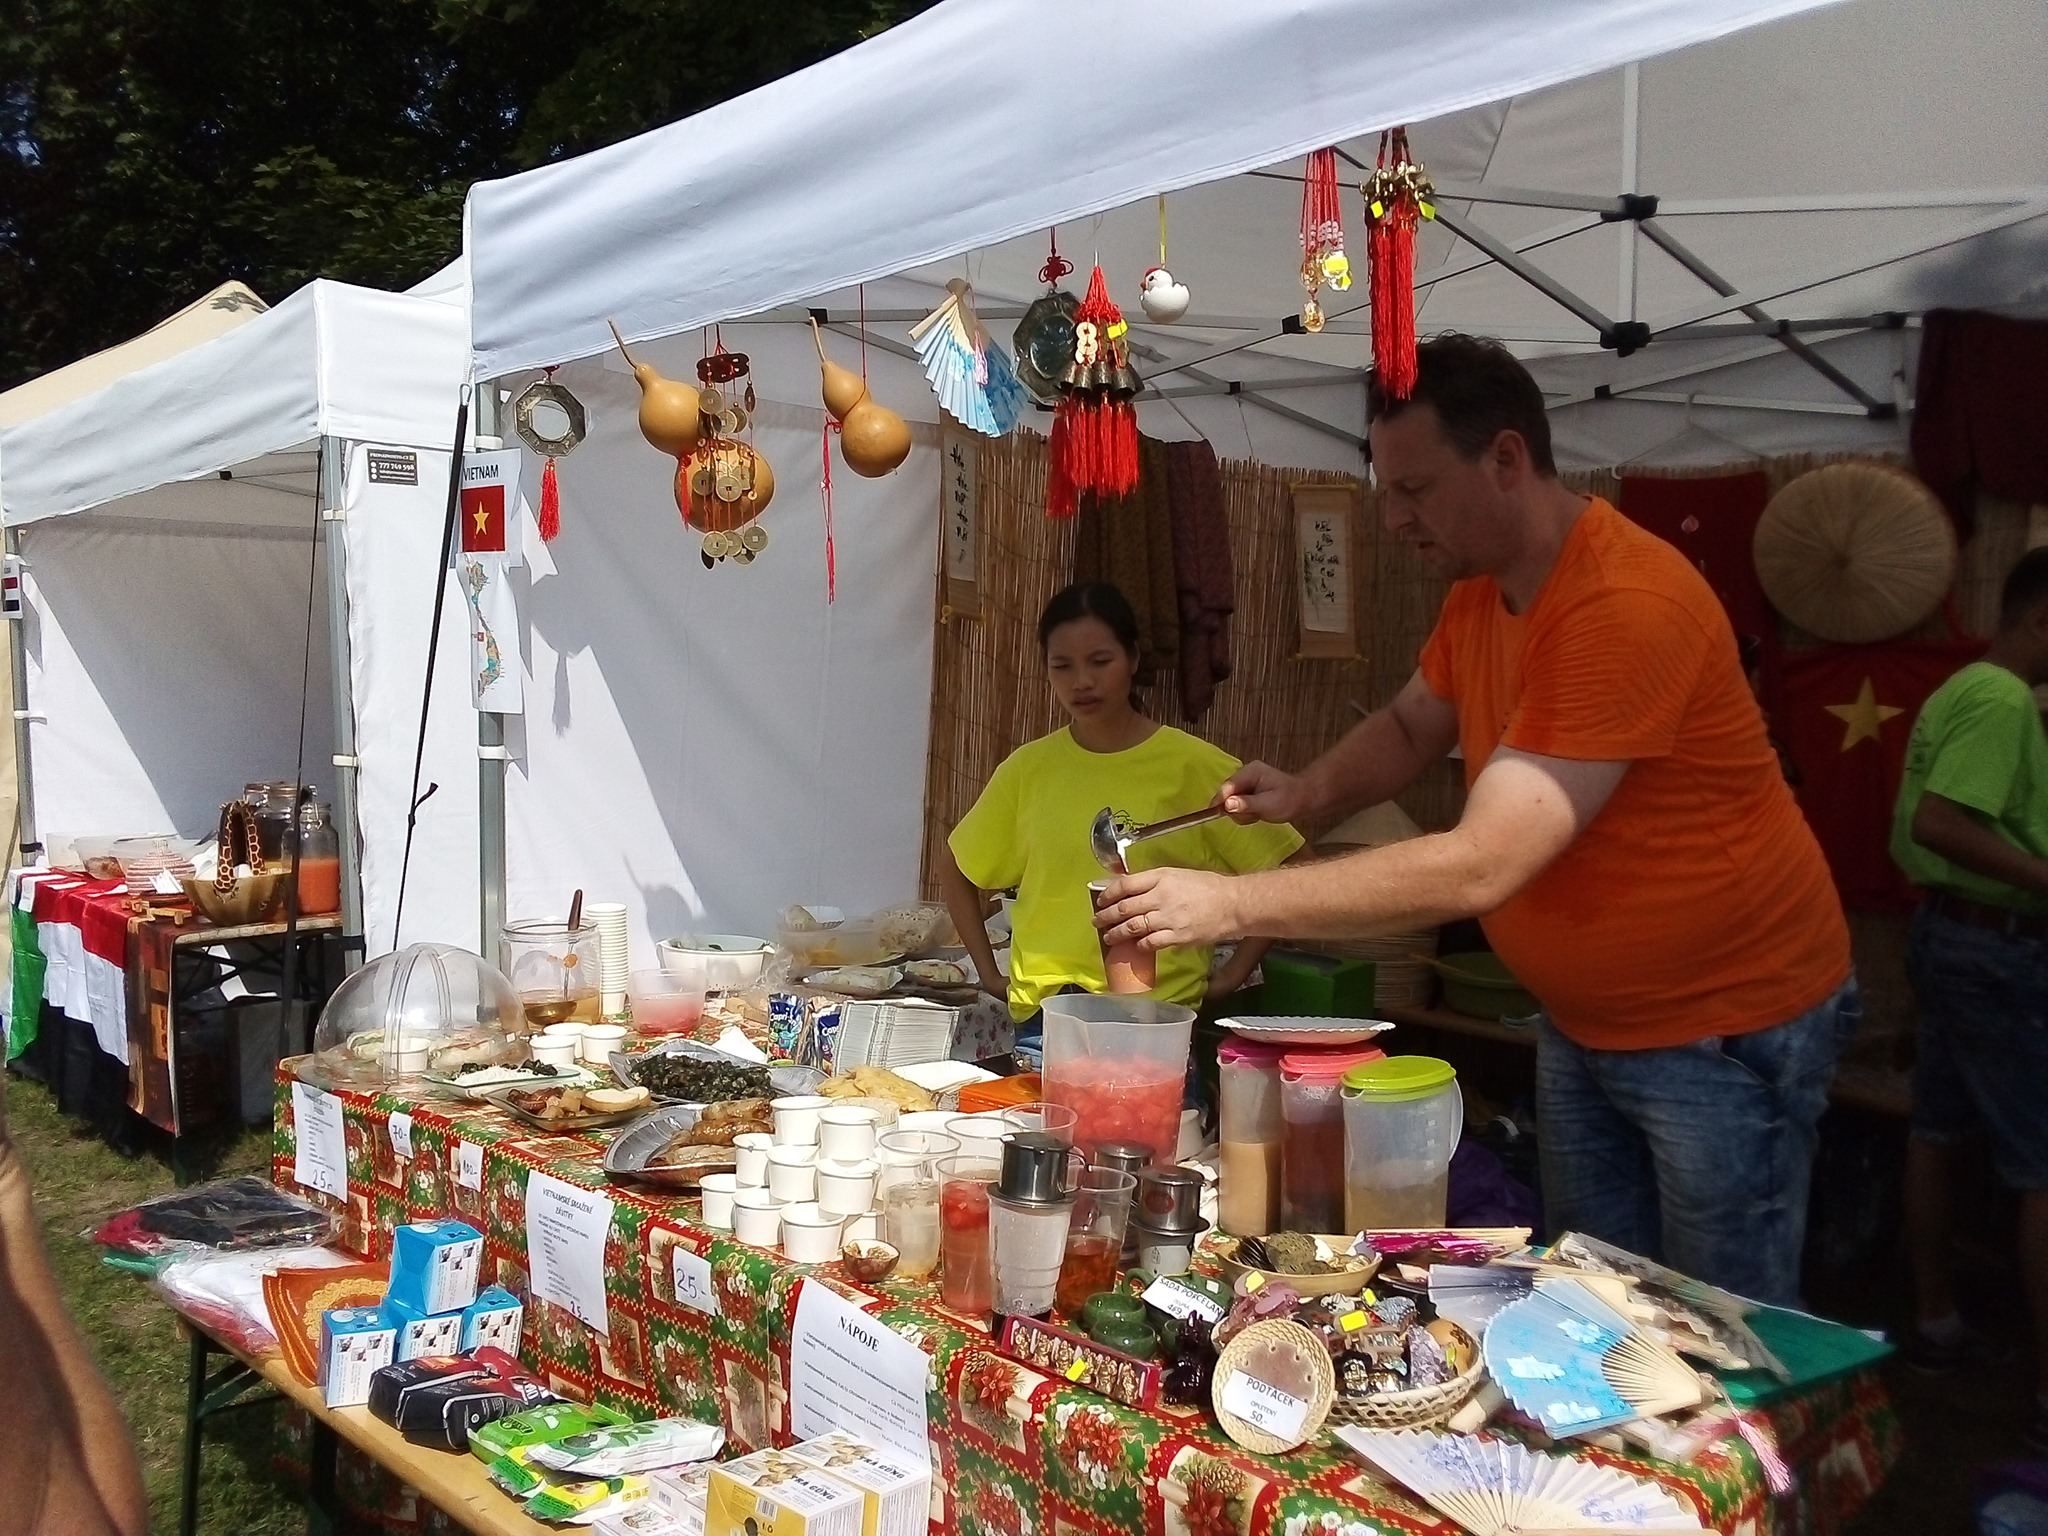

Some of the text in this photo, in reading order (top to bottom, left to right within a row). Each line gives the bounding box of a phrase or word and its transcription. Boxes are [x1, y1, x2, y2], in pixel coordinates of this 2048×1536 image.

[463, 465, 499, 481] VIETNAM
[1159, 1278, 1180, 1292] SADA
[837, 1315, 880, 1352] NÁPOJE
